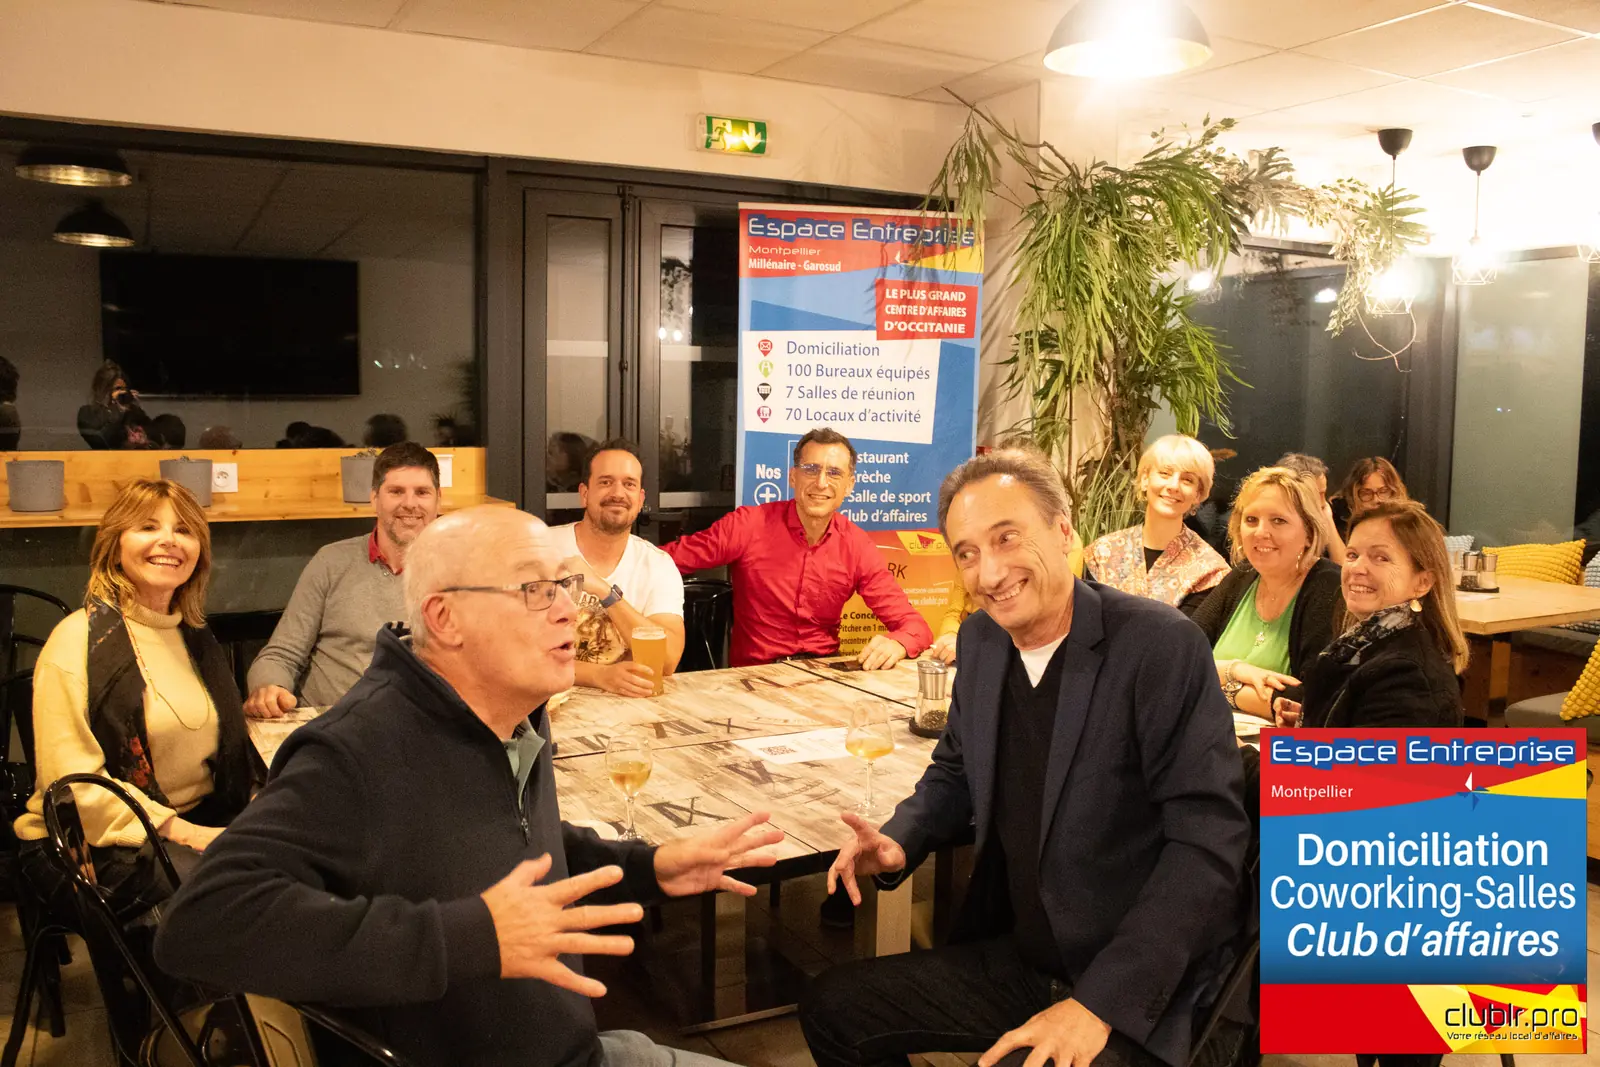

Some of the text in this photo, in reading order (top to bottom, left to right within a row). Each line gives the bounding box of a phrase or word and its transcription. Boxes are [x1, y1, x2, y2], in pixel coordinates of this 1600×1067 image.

[748, 217, 845, 239] Espace
[748, 245, 821, 257] Montpellier
[748, 258, 797, 270] Millénaire
[803, 260, 842, 272] Garosud
[885, 288, 966, 302] LE PLUS GRAND
[885, 304, 967, 318] CENTRE D'AFFAIRES
[884, 320, 966, 334] D'OCCITANIE
[786, 340, 881, 357] Domiciliation
[787, 364, 930, 383] 100 Bureaux équipés
[786, 386, 916, 402] 7 Salles de réunion
[785, 408, 922, 424] 70 Locaux d'activité
[856, 451, 910, 465] staurant
[755, 464, 782, 480] Nos
[854, 470, 892, 484] rèche
[847, 490, 932, 508] Salle de sport
[870, 508, 928, 524] d'affaires
[850, 612, 877, 622] Conce
[840, 636, 868, 645] encontrer
